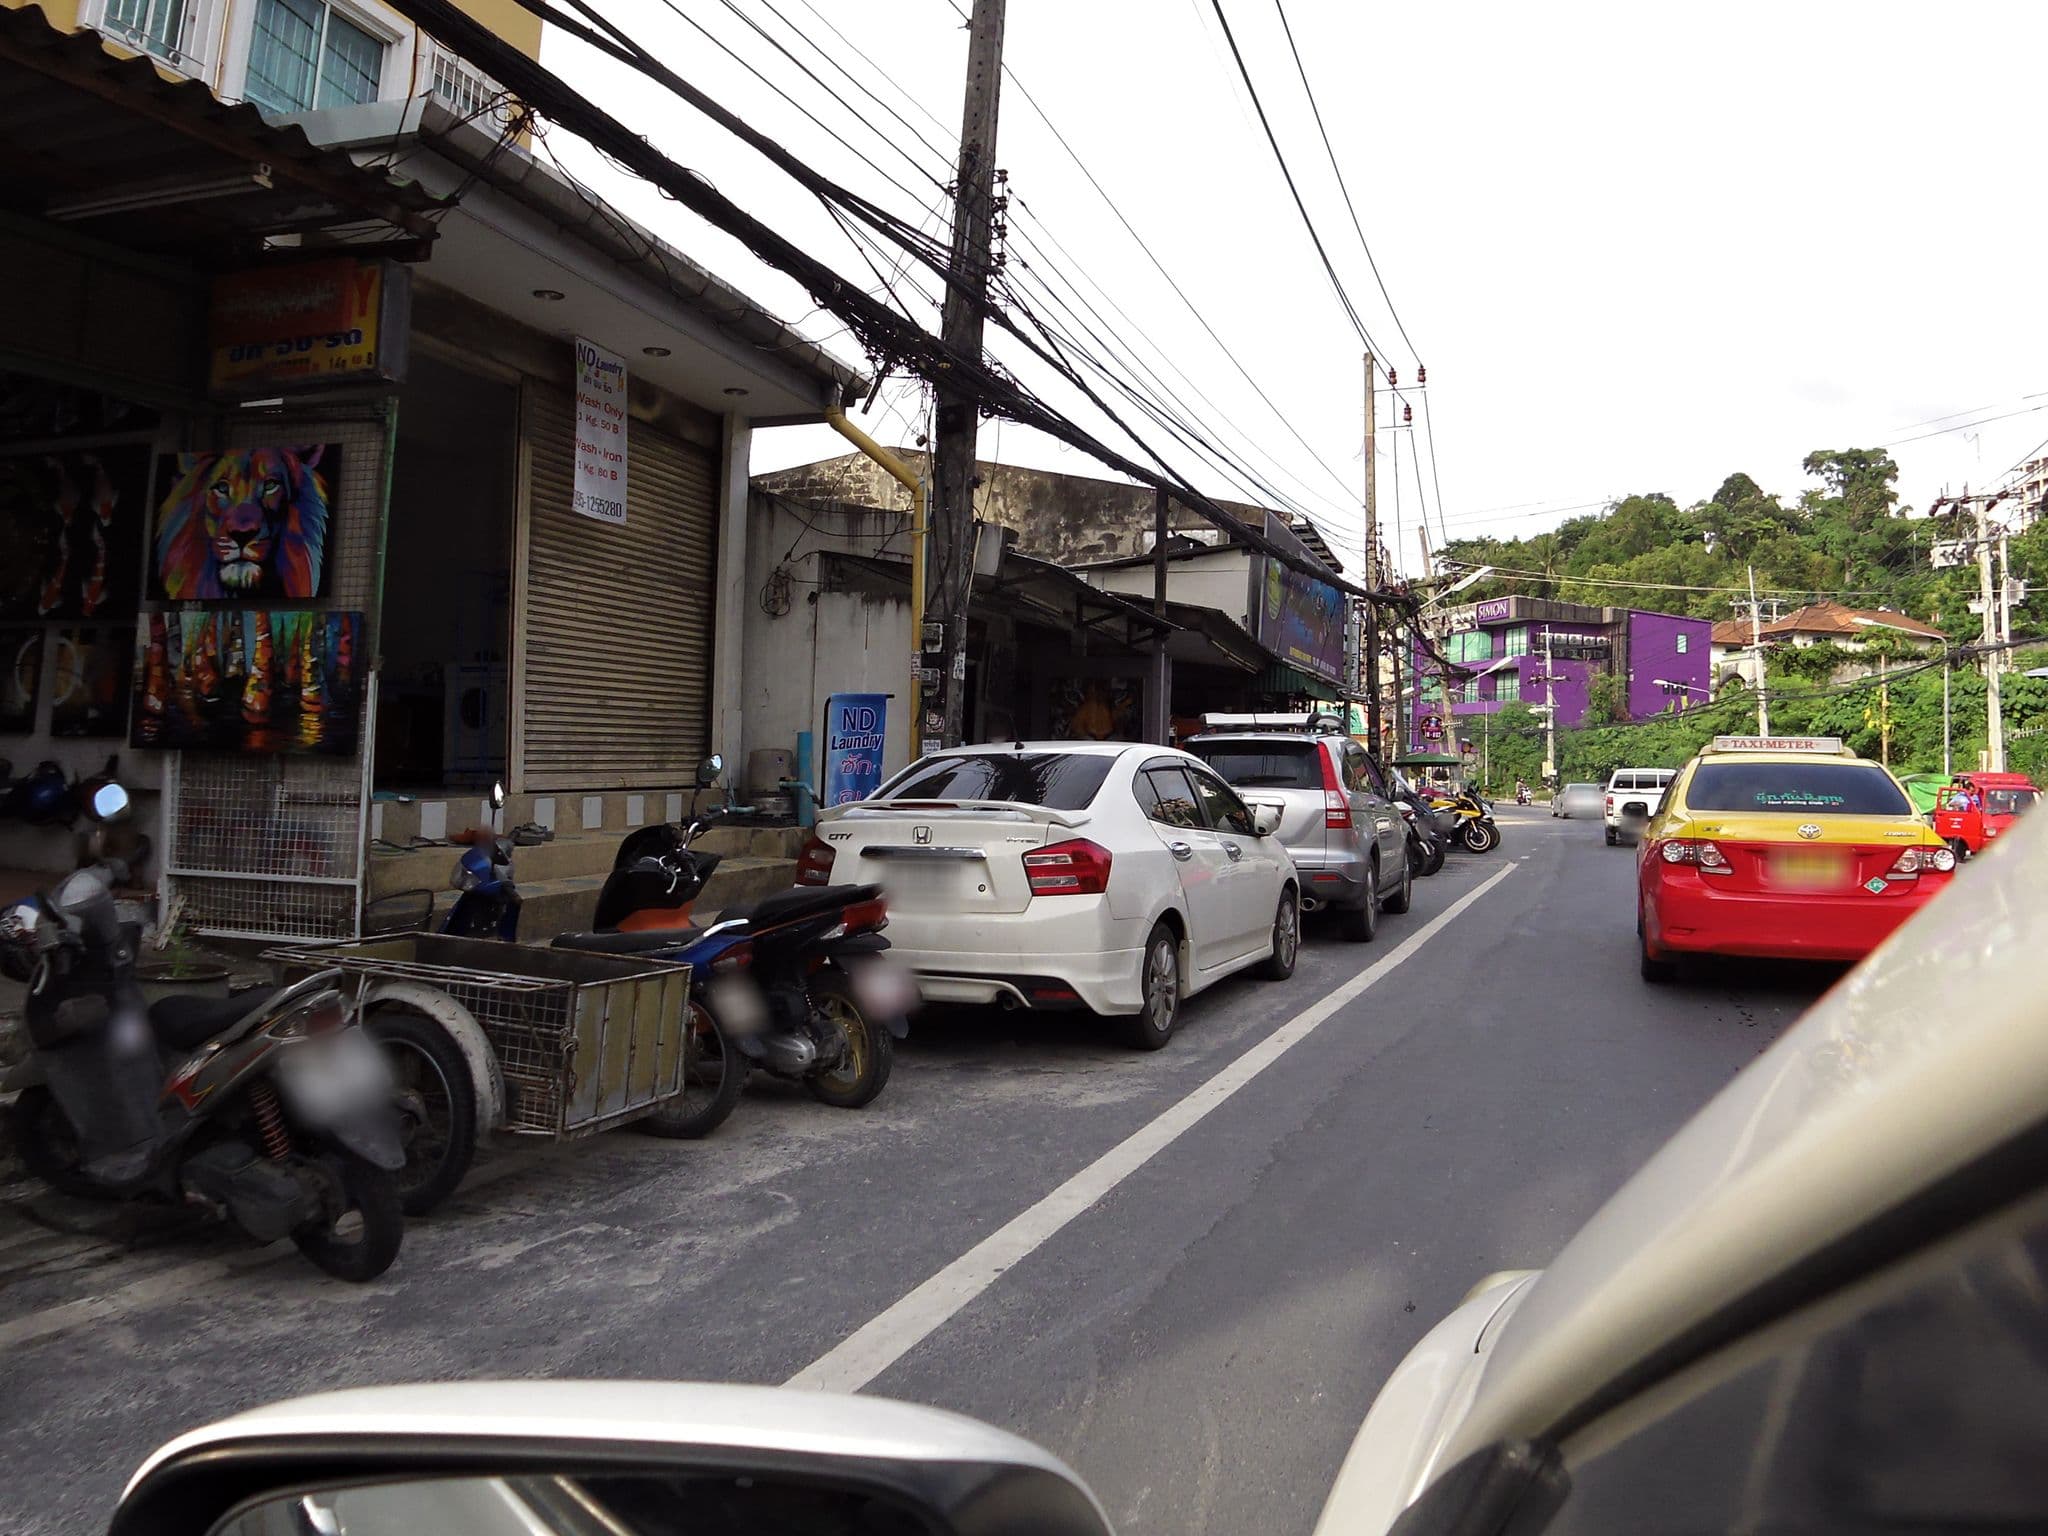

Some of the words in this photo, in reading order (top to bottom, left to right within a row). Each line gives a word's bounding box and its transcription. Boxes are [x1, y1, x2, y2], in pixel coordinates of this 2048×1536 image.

[577, 342, 596, 367] ND
[596, 358, 623, 376] Laundry
[576, 391, 601, 410] Wash
[604, 402, 624, 421] Only
[1478, 602, 1507, 619] SIMON
[841, 706, 876, 732] ND
[831, 733, 883, 751] Laundry
[842, 752, 873, 774] ซัก
[828, 832, 853, 841] CITY
